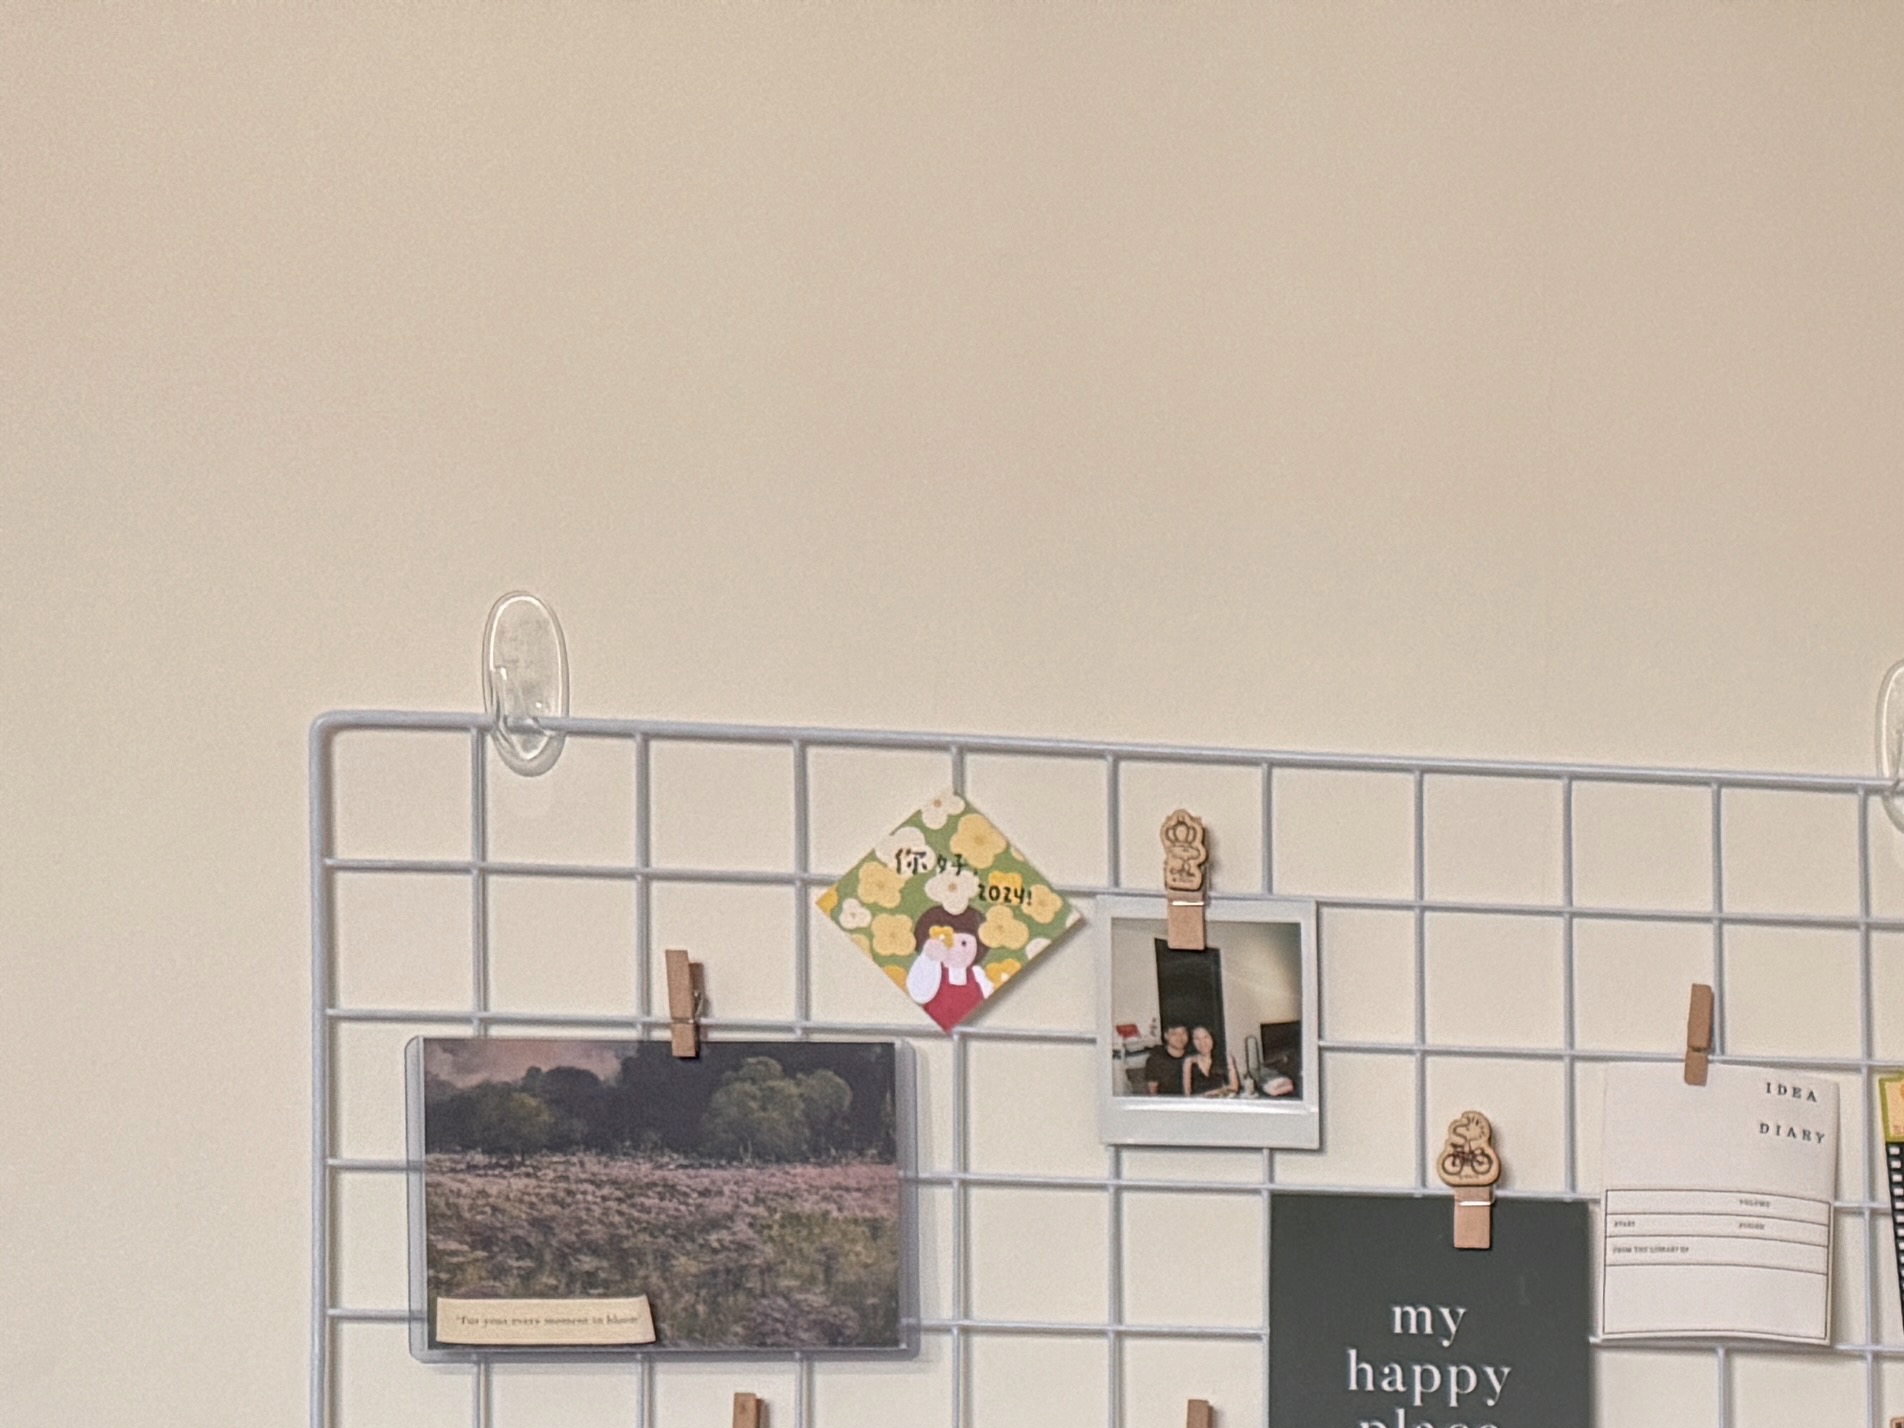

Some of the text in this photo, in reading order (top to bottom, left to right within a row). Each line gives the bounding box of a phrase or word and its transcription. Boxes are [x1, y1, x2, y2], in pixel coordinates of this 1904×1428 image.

[977, 883, 1032, 906] 2024!
[1766, 1082, 1818, 1102] IDEA
[1759, 1122, 1825, 1144] DIARY
[1391, 1303, 1466, 1346] my
[1346, 1348, 1511, 1407] happy
